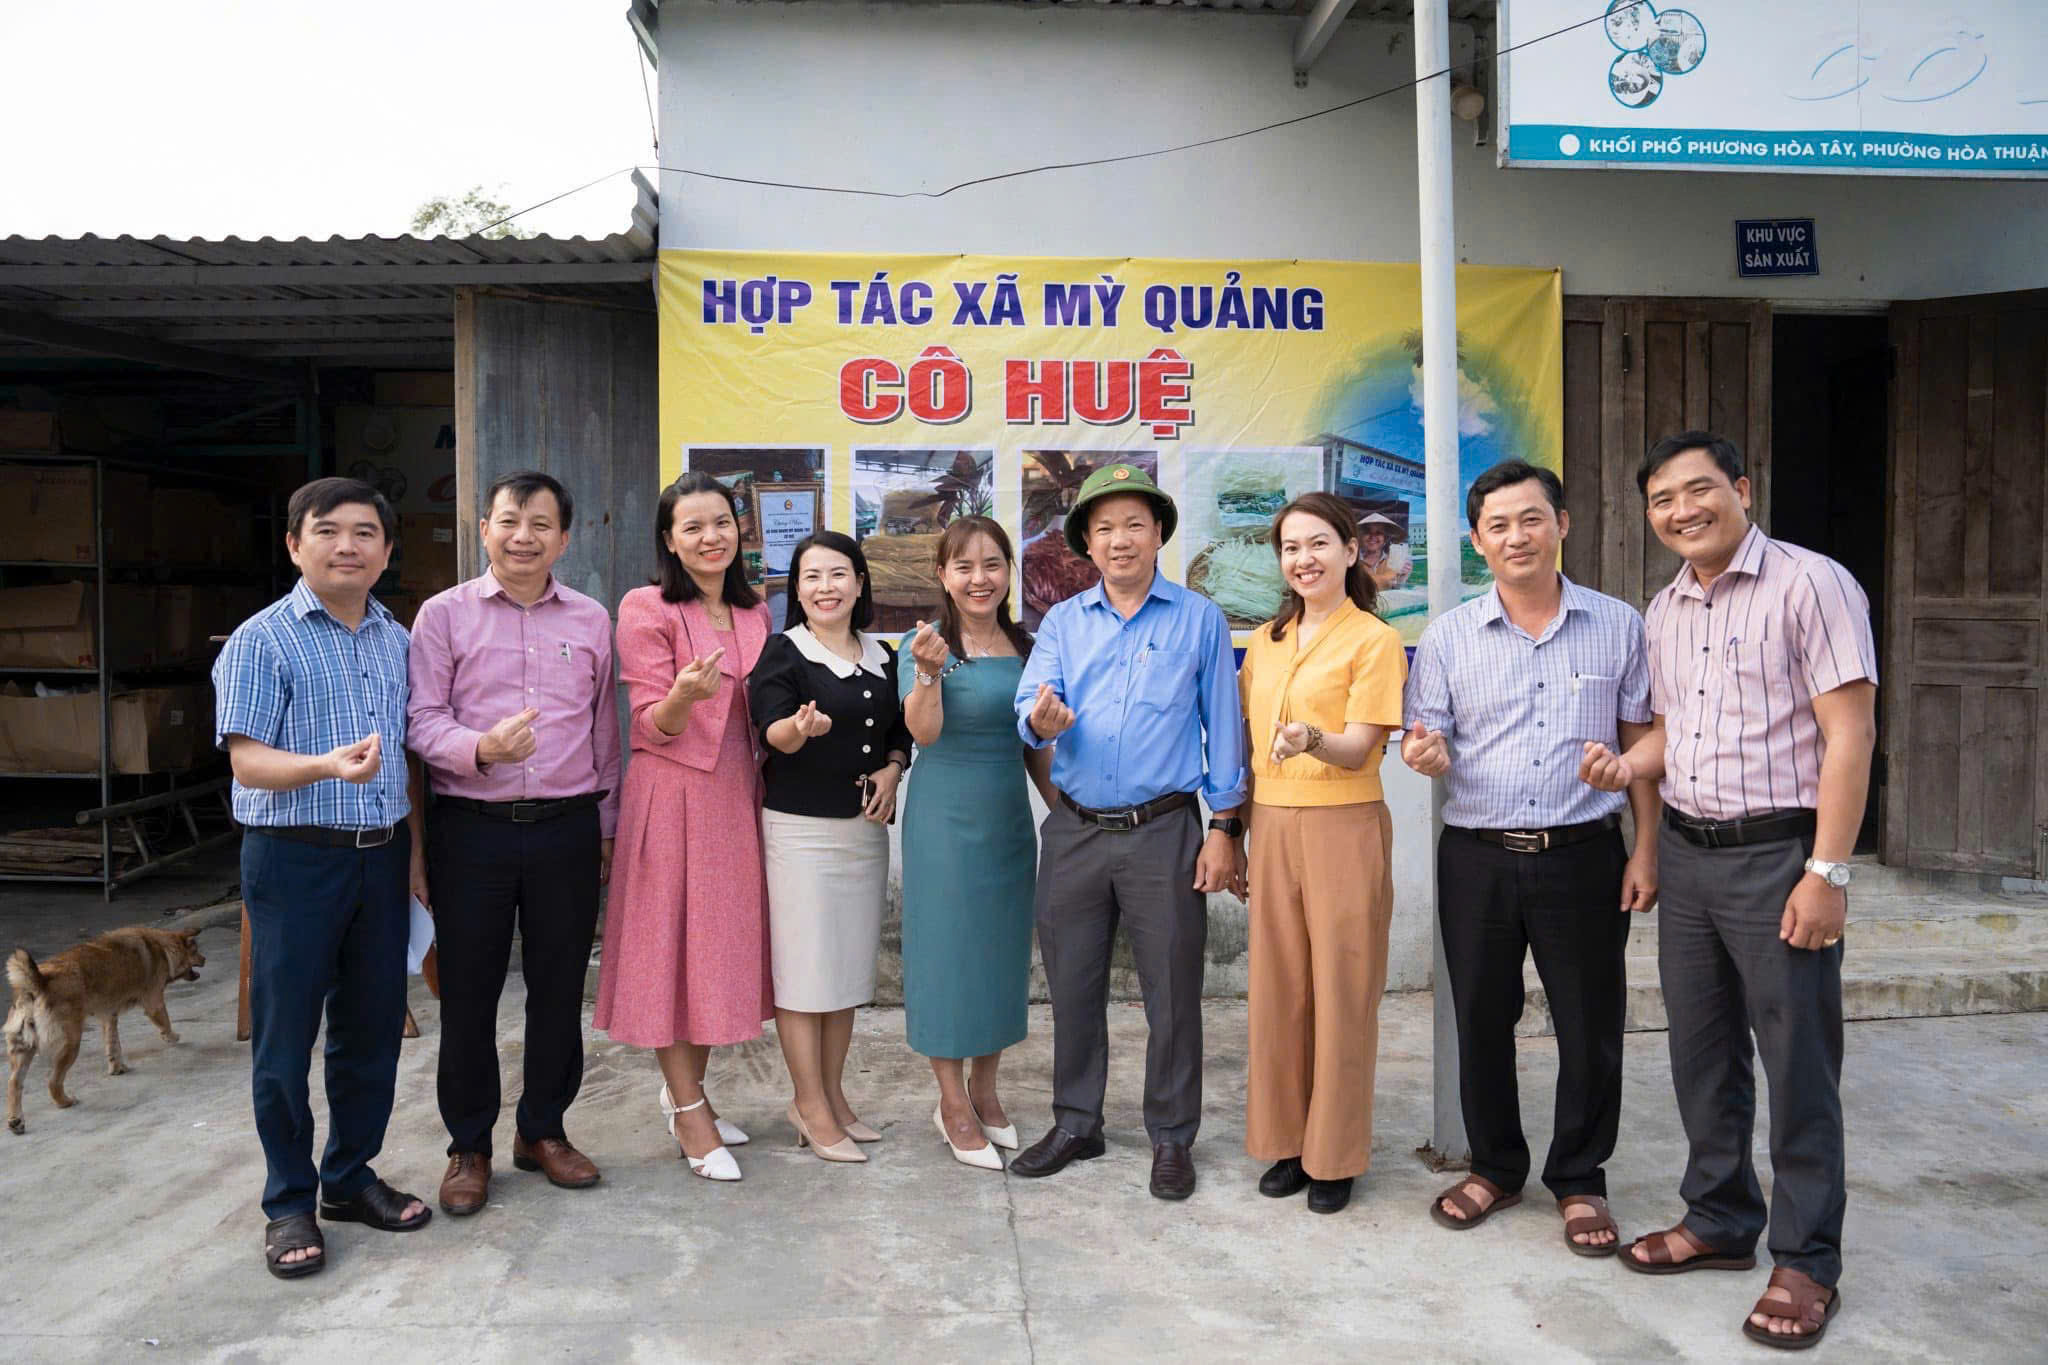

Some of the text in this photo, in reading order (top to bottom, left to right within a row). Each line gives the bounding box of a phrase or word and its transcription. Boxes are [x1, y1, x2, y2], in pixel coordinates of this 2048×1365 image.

[1589, 135, 1636, 153] KHỐI
[1642, 136, 1682, 154] PHỐ
[1688, 140, 1768, 156] PHƯƠNG
[1773, 139, 1815, 156] HÒA
[1820, 139, 1857, 158] TÂY,
[1863, 141, 1941, 159] PHƯỜNG
[1947, 144, 1988, 161] HÒA
[1746, 226, 1806, 245] KHU VỰC
[1745, 246, 1810, 268] SẢN XUẤT
[702, 271, 1325, 335] HỢP TÁC XÃ MỲ QUẢNG
[838, 344, 1196, 441] CÔ HUỆ
